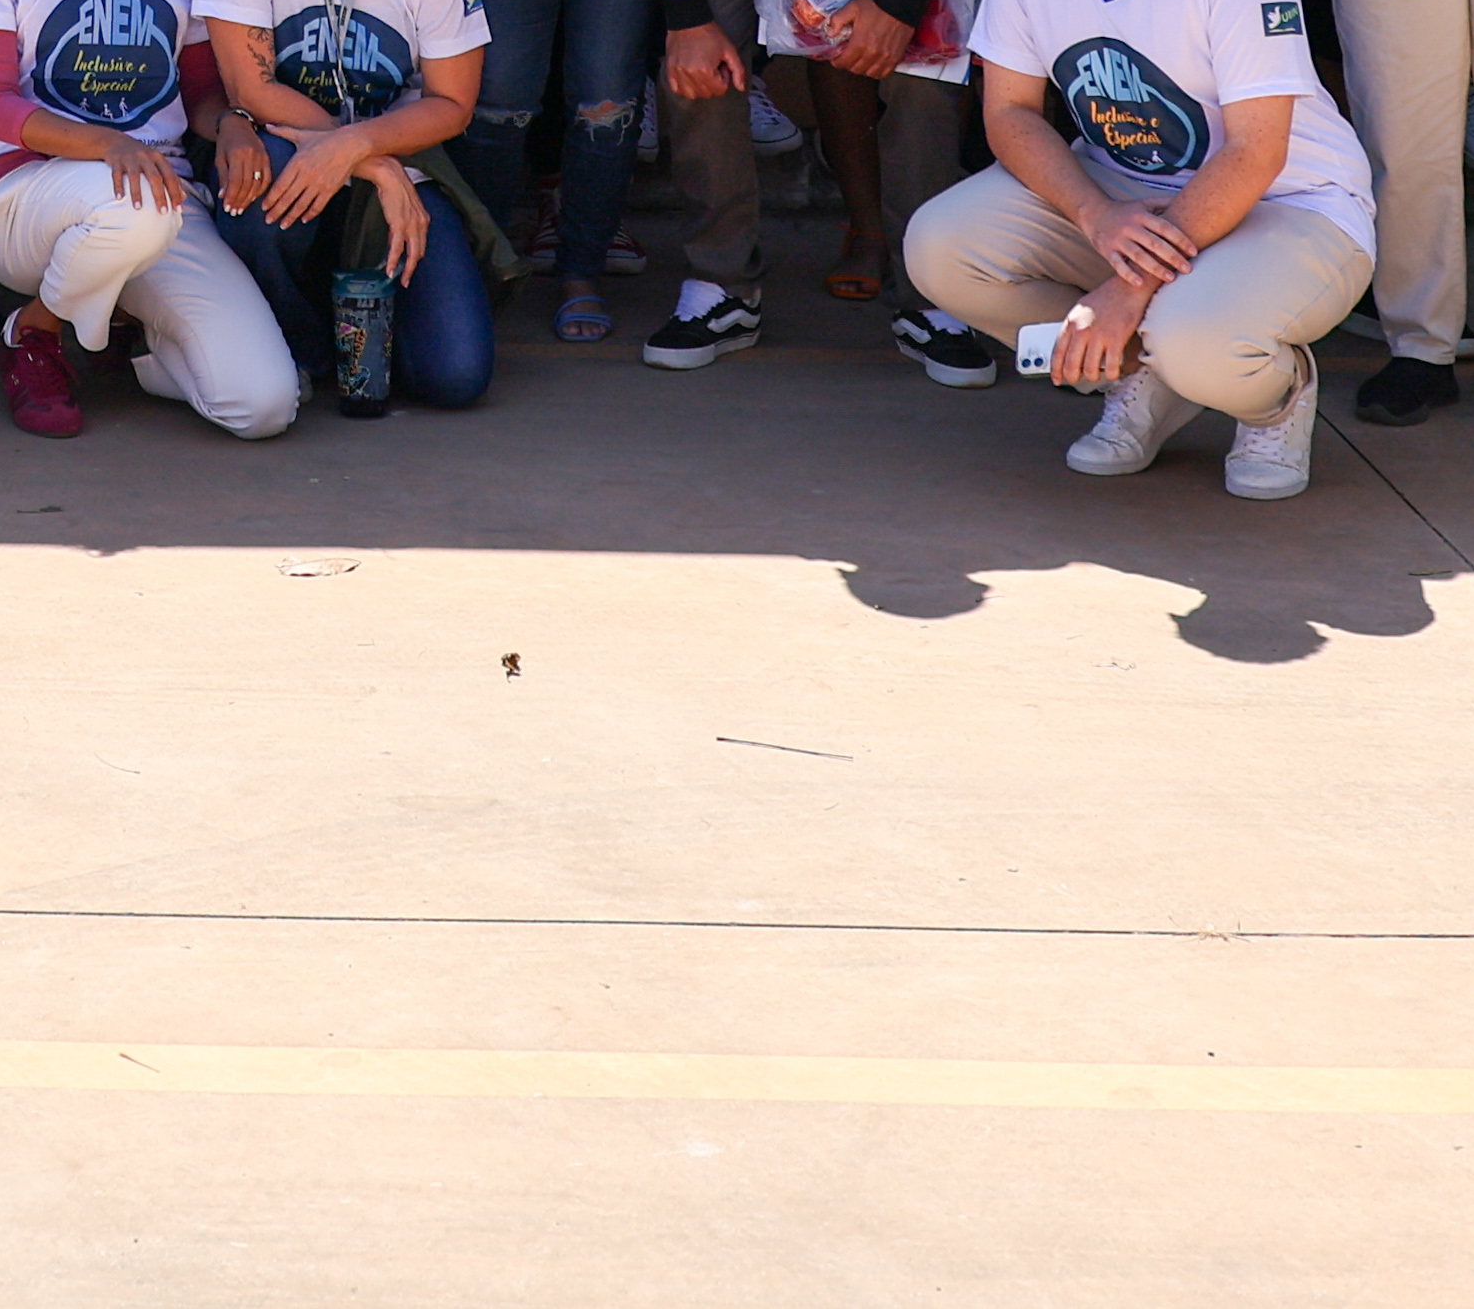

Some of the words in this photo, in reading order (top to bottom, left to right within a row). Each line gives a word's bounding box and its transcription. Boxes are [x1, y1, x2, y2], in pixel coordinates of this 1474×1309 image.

[73, 50, 133, 74] Inclusivo
[80, 71, 137, 96] Especial
[1076, 47, 1150, 103] ENEM
